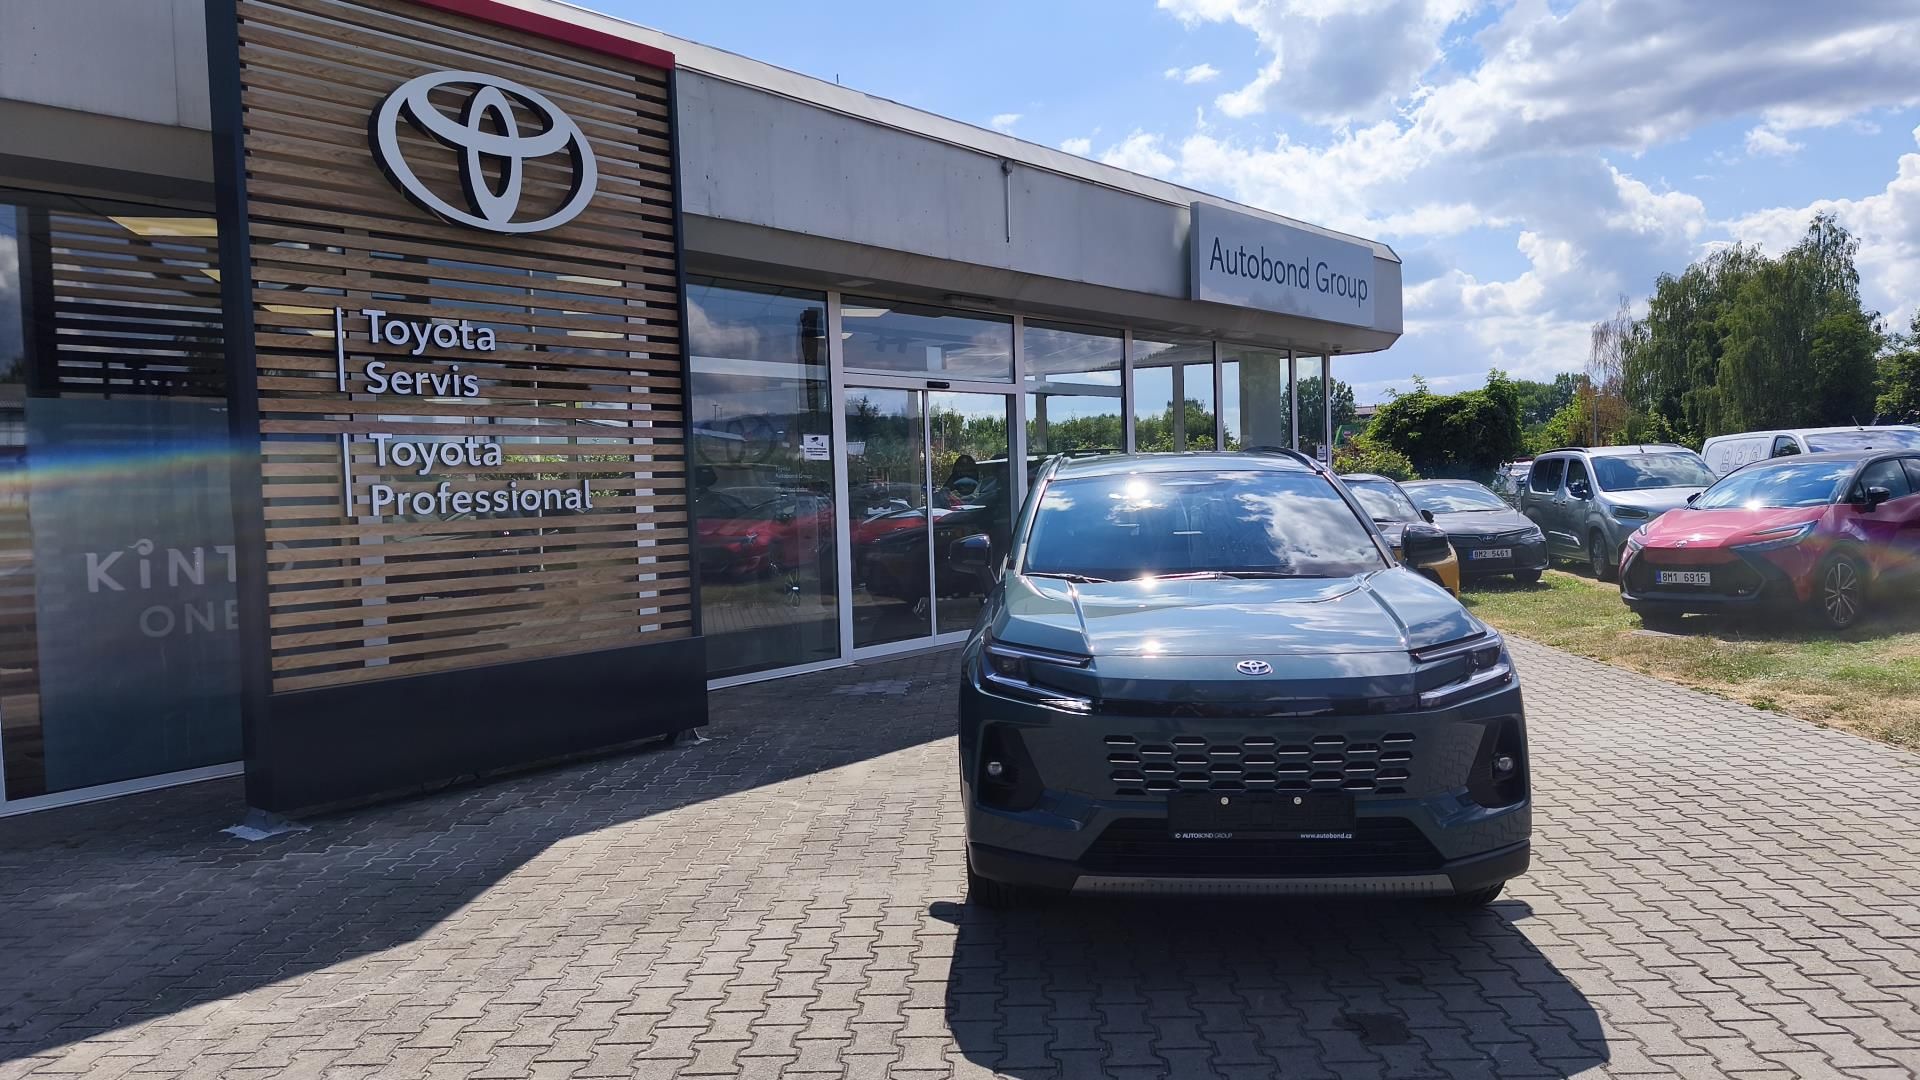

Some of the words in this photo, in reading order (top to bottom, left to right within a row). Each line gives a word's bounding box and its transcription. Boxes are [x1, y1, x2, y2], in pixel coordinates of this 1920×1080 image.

[1209, 236, 1310, 290] Autobond
[1315, 261, 1368, 308] Group
[361, 308, 496, 355] Toyota
[365, 361, 480, 397] Servis
[368, 432, 503, 475] Toyota
[370, 479, 593, 517] Professional
[1662, 572, 1678, 582] 8M1
[1683, 572, 1706, 583] 6915
